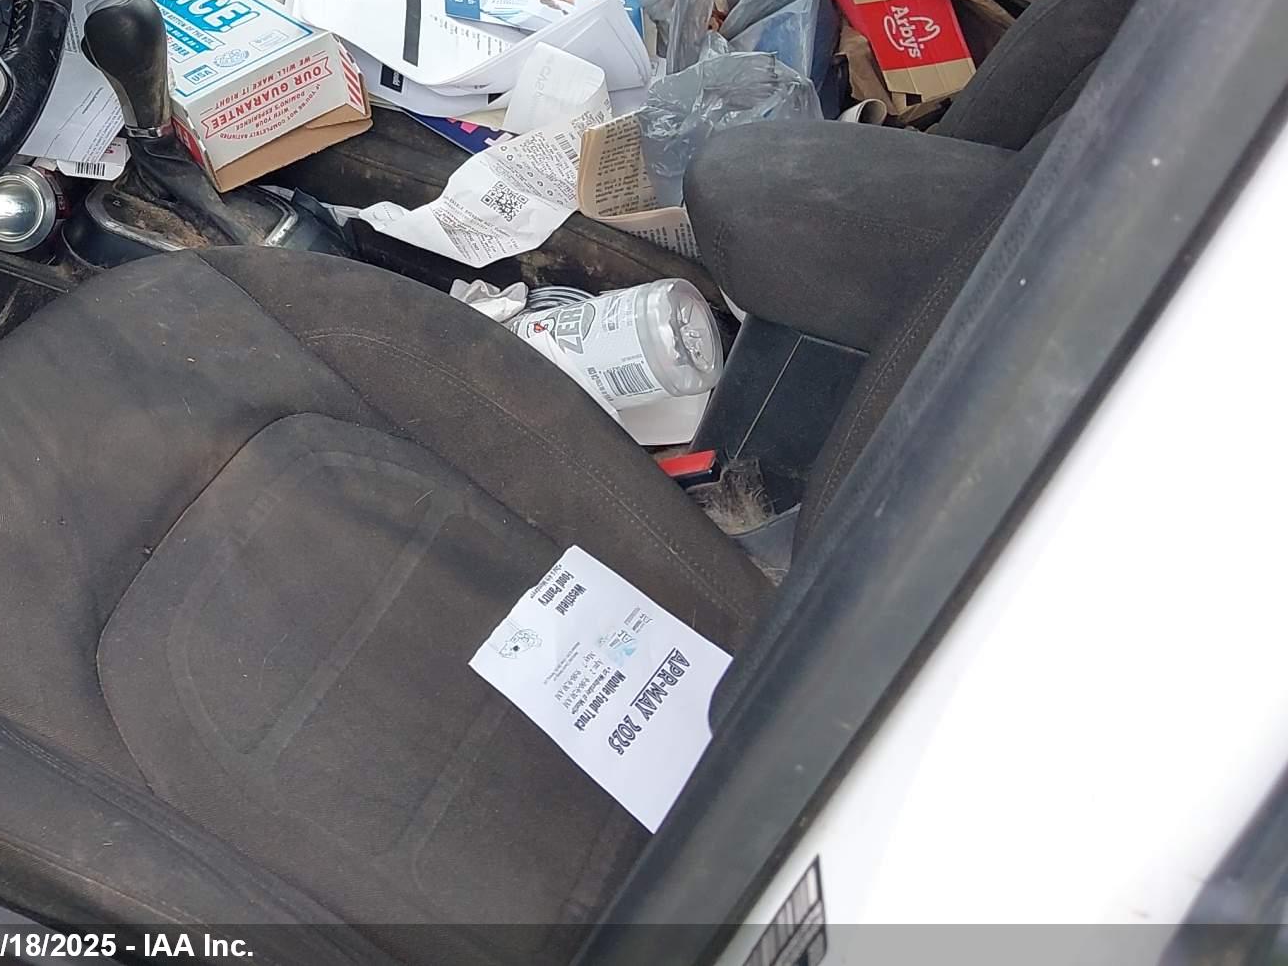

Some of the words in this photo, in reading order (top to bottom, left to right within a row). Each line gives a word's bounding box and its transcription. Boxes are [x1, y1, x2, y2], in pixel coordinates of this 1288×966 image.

[166, 12, 186, 27] BOTTOM
[890, 1, 925, 59] Arby's
[168, 41, 190, 57] FIBER
[276, 62, 297, 77] WILL
[298, 55, 312, 66] WE
[192, 68, 211, 83] USA
[251, 73, 275, 90] MAKE
[292, 65, 323, 87] OUR
[241, 86, 251, 95] IT
[209, 80, 290, 130] GUARANTEE
[213, 92, 239, 109] RIGHT
[273, 90, 306, 111] DOMINO'S
[234, 106, 274, 131] EXPERIENCE
[253, 115, 273, 129] YOUR
[272, 106, 289, 119] WITH
[285, 109, 298, 120] NOT
[249, 118, 285, 138] COMPLETELY
[554, 303, 586, 355] ZER
[554, 569, 574, 588] Food
[536, 583, 562, 607] Pantry
[554, 582, 586, 616] Westfield
[582, 650, 596, 663] May
[584, 673, 605, 695] Wednesday
[601, 669, 626, 696] Mobile
[633, 649, 691, 721] APR-MAY
[554, 688, 565, 700] AM
[562, 696, 573, 709] AM
[587, 691, 608, 713] Food
[573, 708, 595, 732] Truck
[605, 713, 642, 756] 2025
